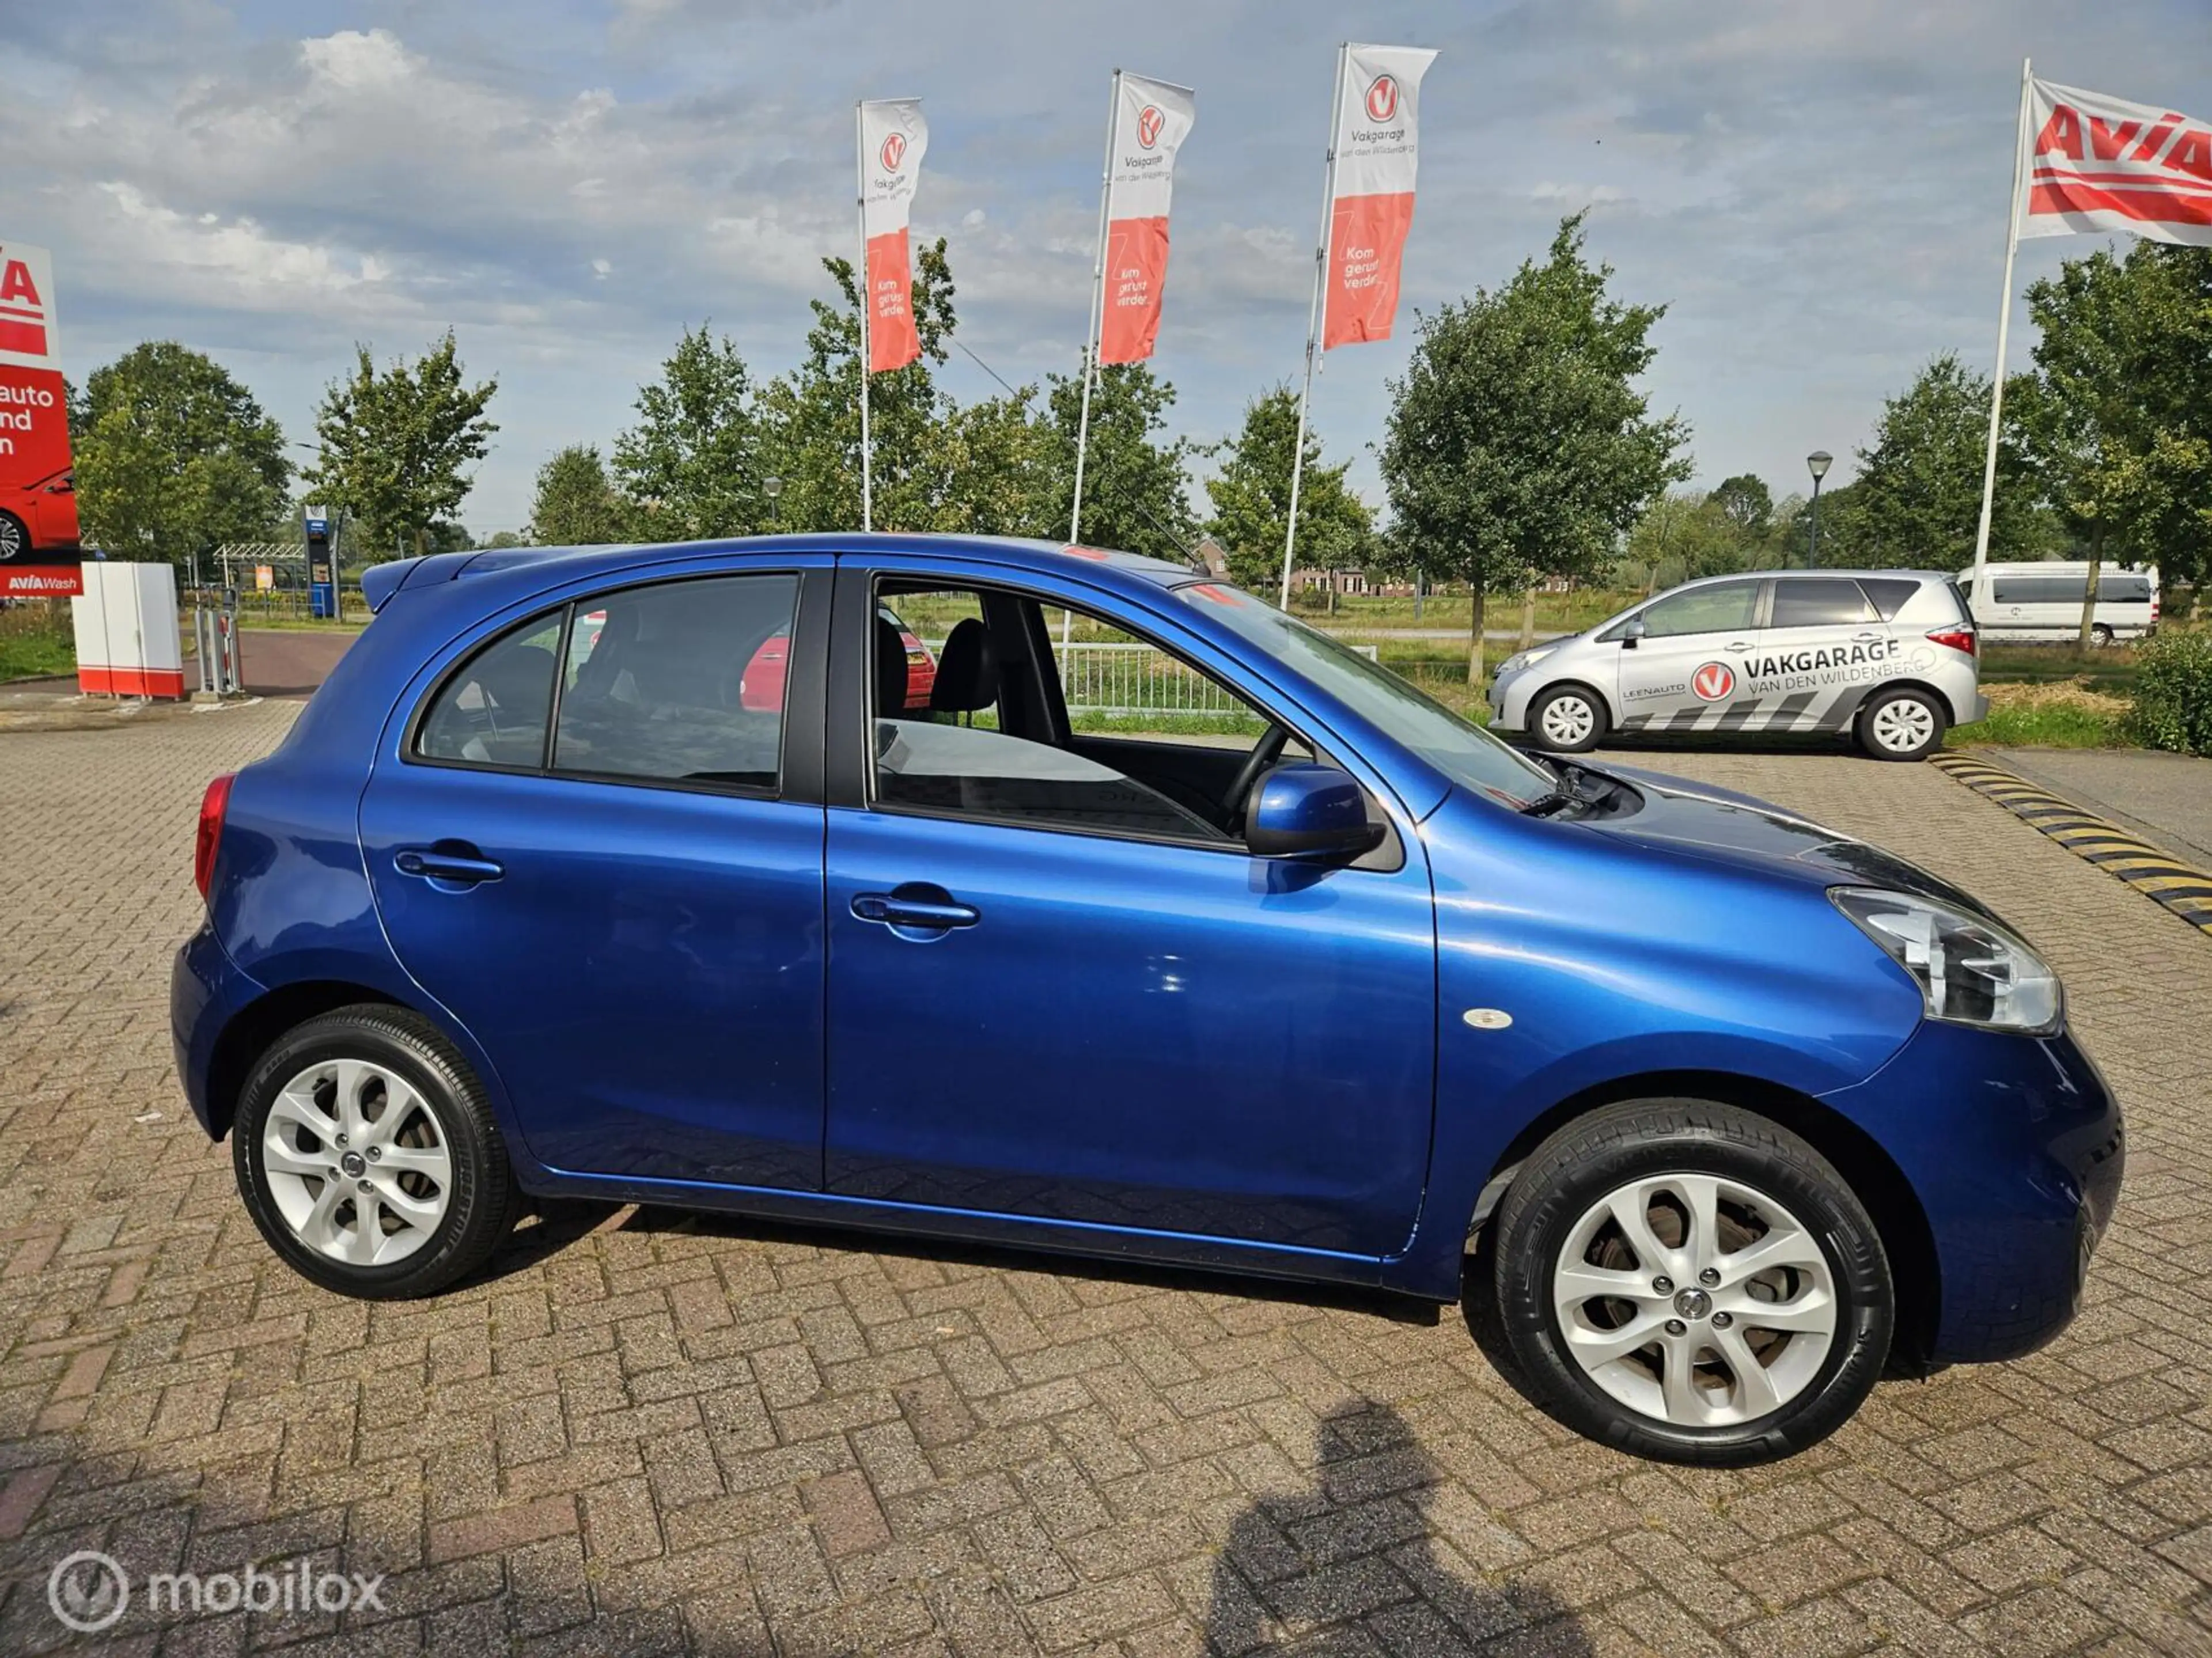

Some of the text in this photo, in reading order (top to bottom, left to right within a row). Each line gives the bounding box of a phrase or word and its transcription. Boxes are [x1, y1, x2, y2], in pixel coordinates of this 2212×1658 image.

[1347, 246, 1374, 260] Kom
[1744, 639, 1901, 678] VAKGARAGE
[1748, 659, 1924, 694] VAN DEN WILDENBERG
[1623, 684, 1685, 698] LEENAUTO
